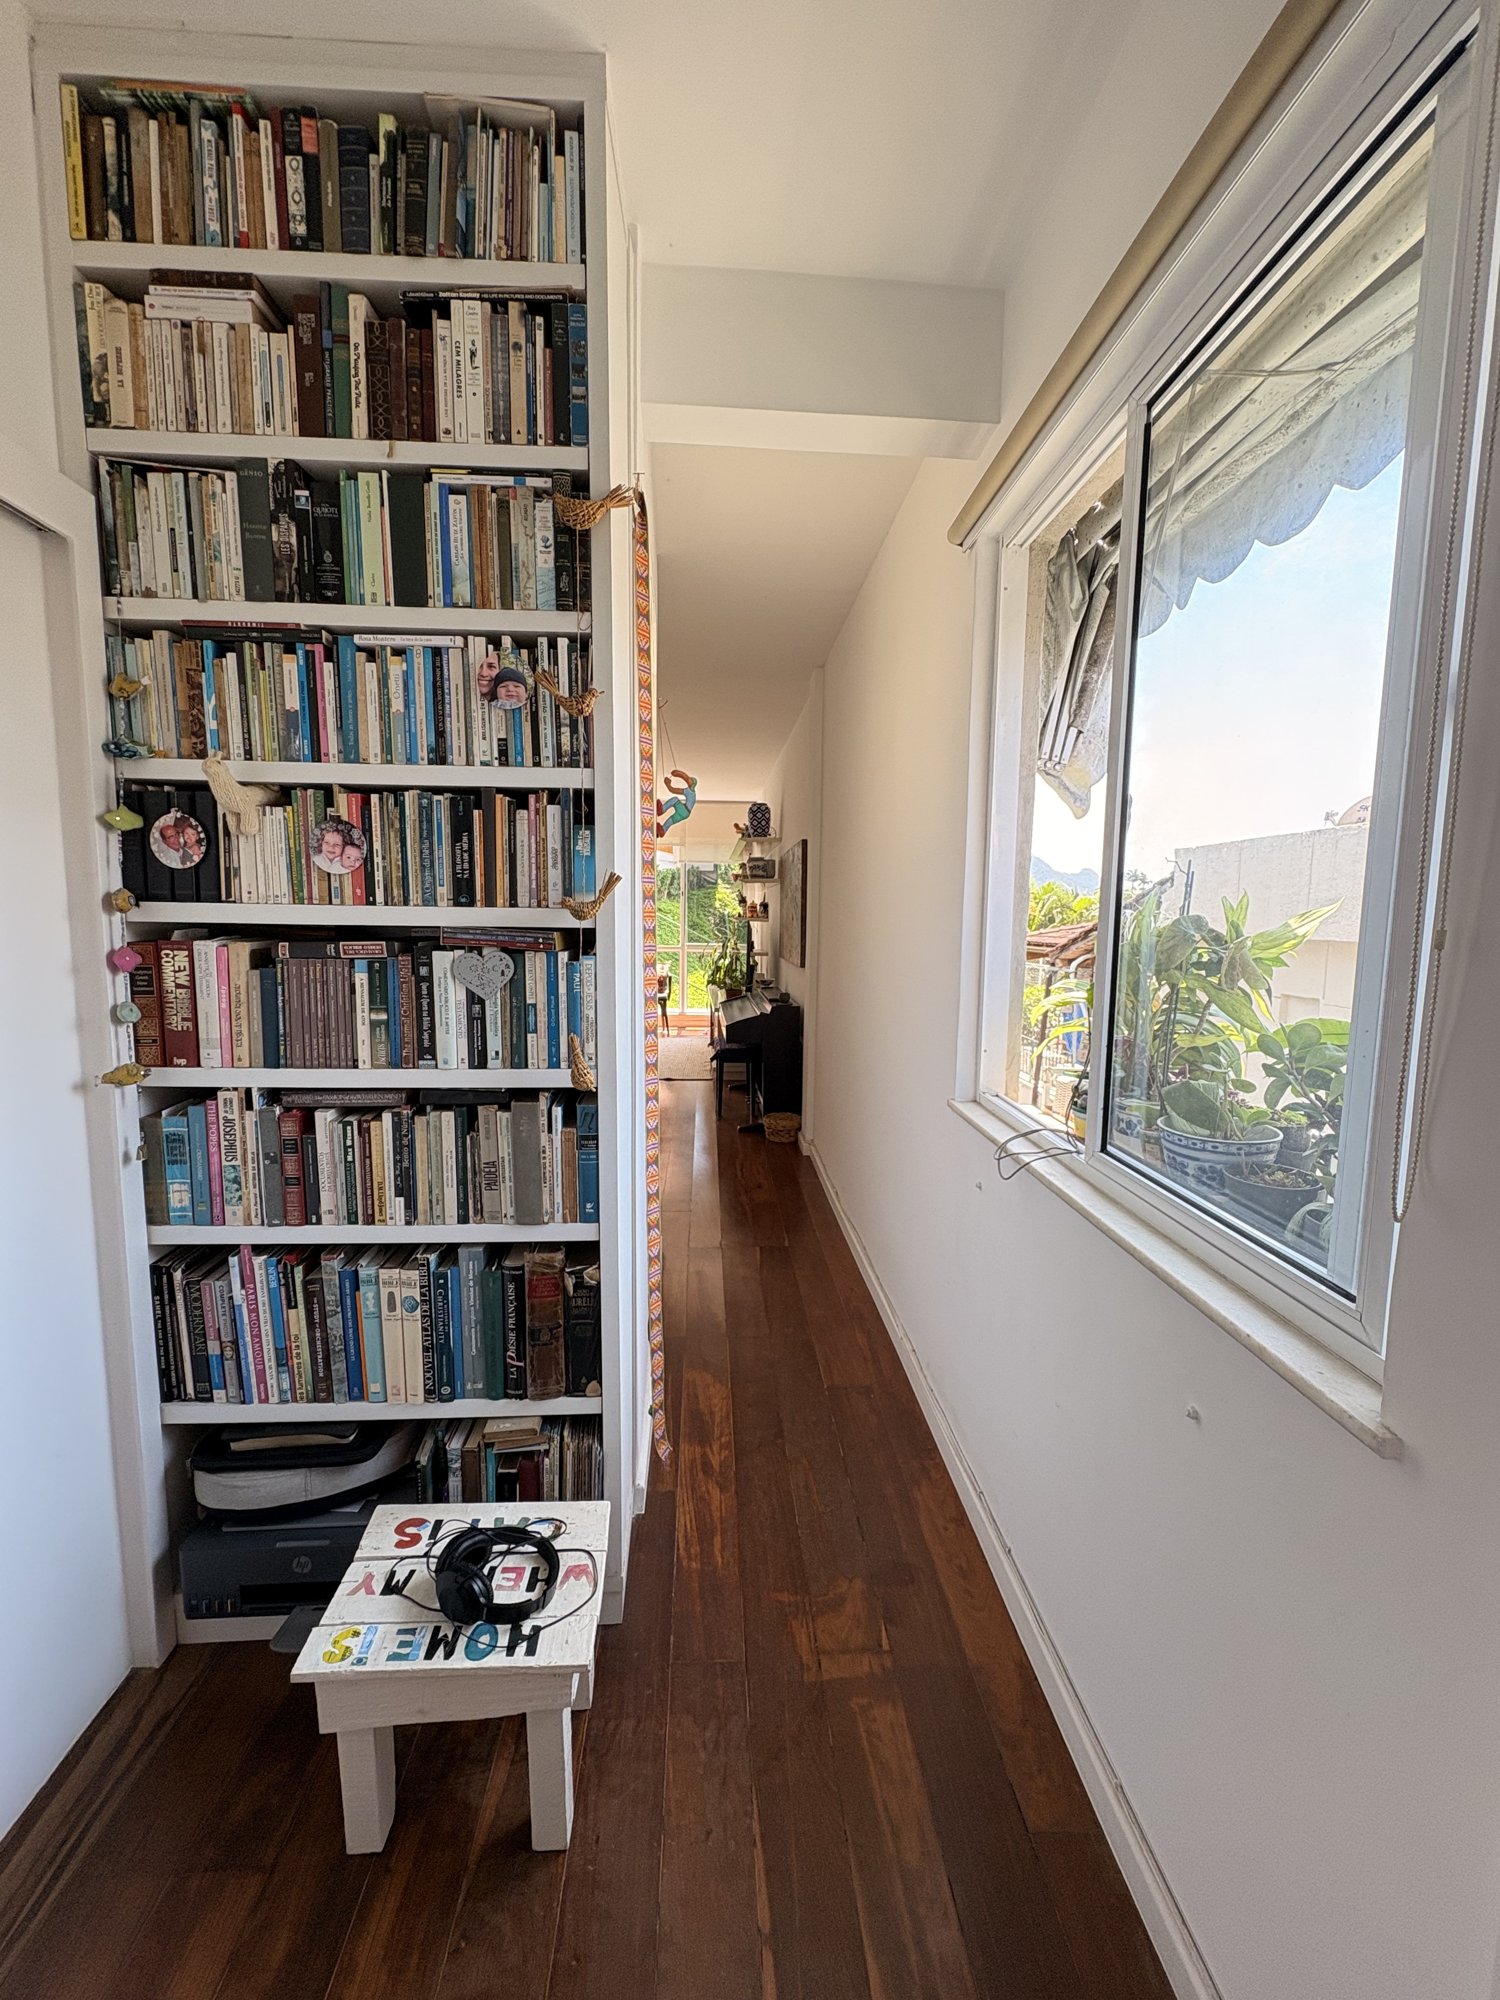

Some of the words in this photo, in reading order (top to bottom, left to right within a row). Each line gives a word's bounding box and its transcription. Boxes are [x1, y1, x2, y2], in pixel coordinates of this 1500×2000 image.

[280, 544, 290, 554] LES
[393, 673, 401, 699] Onetti
[424, 868, 433, 891] Origem
[173, 950, 190, 986] NEW
[399, 968, 409, 981] Life
[585, 963, 593, 987] DEPOIS
[160, 950, 177, 1030] COMMENTARY
[401, 983, 410, 1015] Christian
[420, 982, 430, 995] Quem
[585, 992, 593, 1011] JESUS
[176, 988, 192, 1032] BIBLE
[420, 999, 430, 1011] Quem
[402, 1017, 410, 1042] normal
[422, 1017, 431, 1030] Bíblia
[403, 1043, 411, 1056] The
[207, 1105, 216, 1123] THE
[209, 1124, 218, 1152] POPES
[222, 1116, 238, 1162] JOSEPHUS
[401, 1137, 409, 1146] de
[401, 1148, 409, 1167] Bento
[319, 1152, 327, 1192] DOCUMENTOS
[482, 1160, 499, 1191] PAIDÉIA
[269, 1266, 277, 1288] BERLIN
[418, 1257, 428, 1286] BIBLE
[218, 1285, 227, 1317] COMPLETE
[246, 1283, 256, 1309] PARIS
[420, 1287, 429, 1299] LA
[507, 1282, 516, 1328] FRANÇAISE
[189, 1284, 205, 1336] MODERN
[250, 1312, 259, 1335] MON
[436, 1289, 445, 1344] CHRISTIANITY
[421, 1316, 432, 1346] ATLAS
[196, 1337, 207, 1356] ART
[253, 1337, 263, 1371] AMOUR
[315, 1328, 324, 1377] ORCHESTRATION
[296, 1361, 304, 1390] lumières
[423, 1349, 434, 1390] NOUVEL
[346, 1568, 416, 1596] MY
[385, 1622, 542, 1662] HOME
